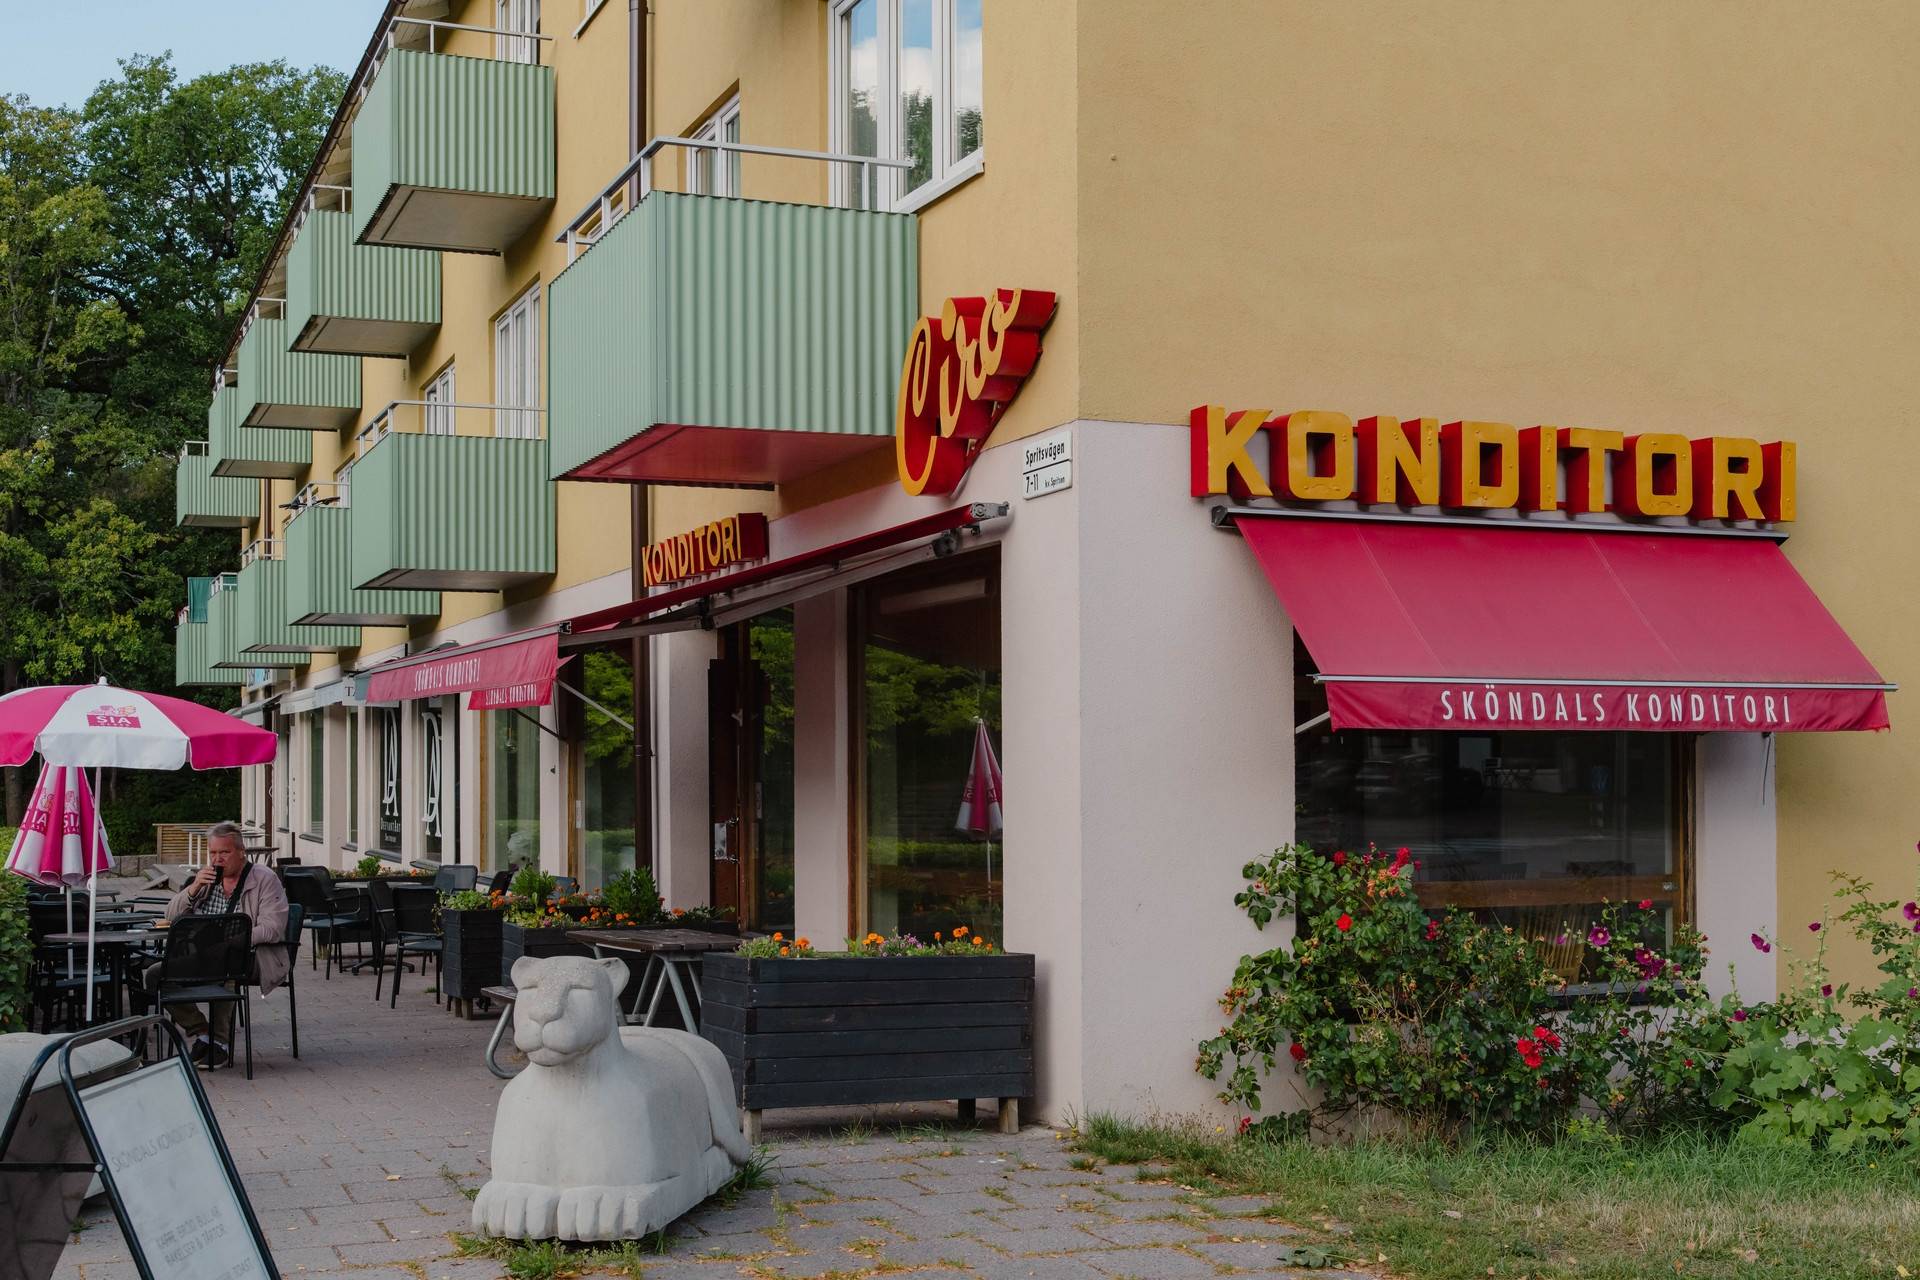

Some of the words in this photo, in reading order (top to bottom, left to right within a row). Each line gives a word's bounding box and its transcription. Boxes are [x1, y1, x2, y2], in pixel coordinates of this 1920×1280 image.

[897, 287, 1026, 497] Ciro
[1025, 442, 1065, 467] Spritsvägen
[1193, 404, 1797, 523] KONDITORI
[1025, 473, 1040, 493] 7-11
[641, 514, 743, 587] KONDITORI
[445, 657, 481, 687] KONDITORI
[96, 715, 131, 725] SIA
[1441, 683, 1606, 722] SKÖNDALS
[1627, 693, 1791, 724] KONDITORI
